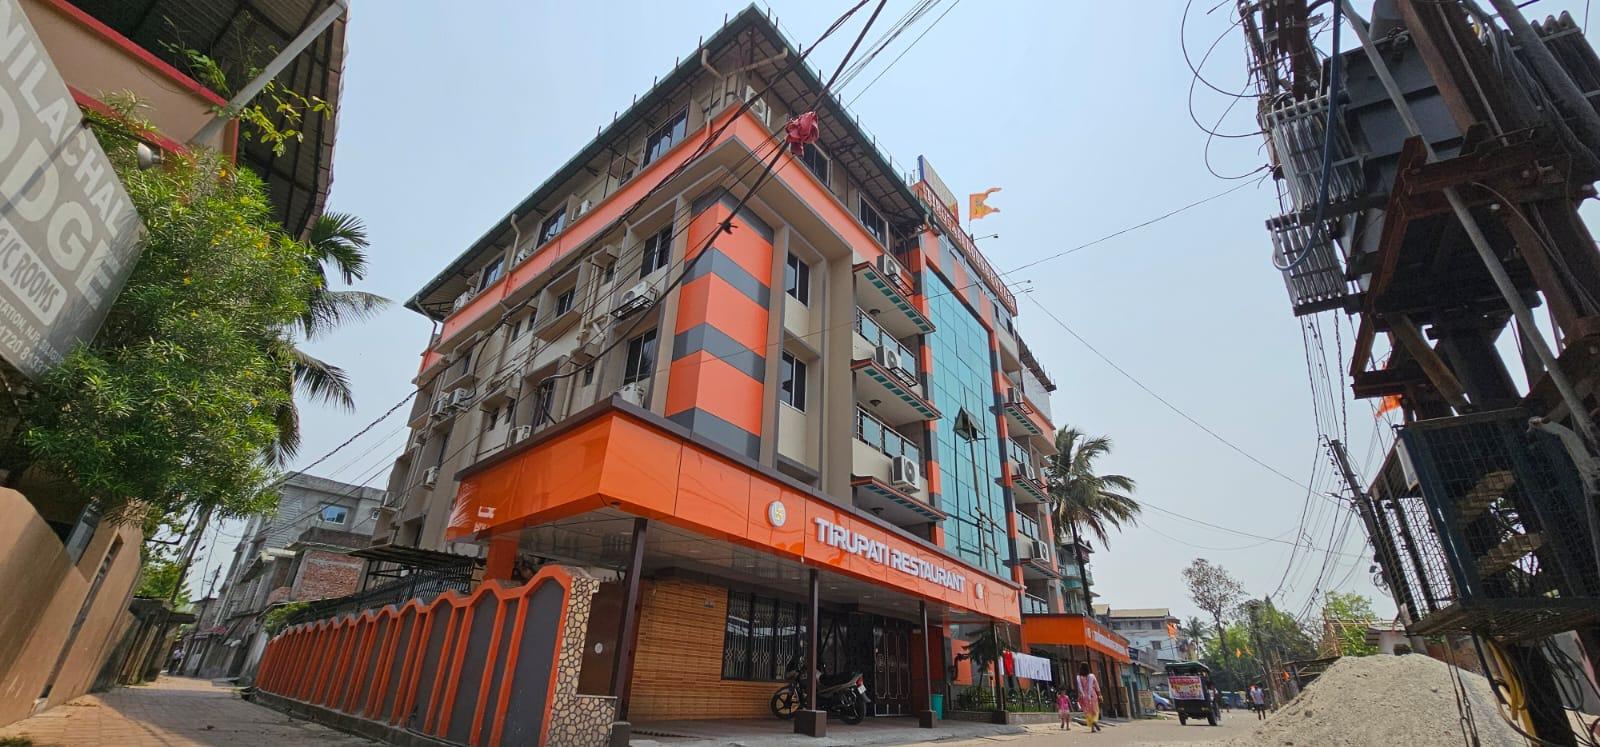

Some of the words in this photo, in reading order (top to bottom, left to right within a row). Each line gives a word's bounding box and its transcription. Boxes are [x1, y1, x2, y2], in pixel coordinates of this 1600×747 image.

[10, 252, 60, 313] ROOMS
[814, 517, 890, 567] TIRUPATI
[890, 548, 966, 593] RESTAURANT
